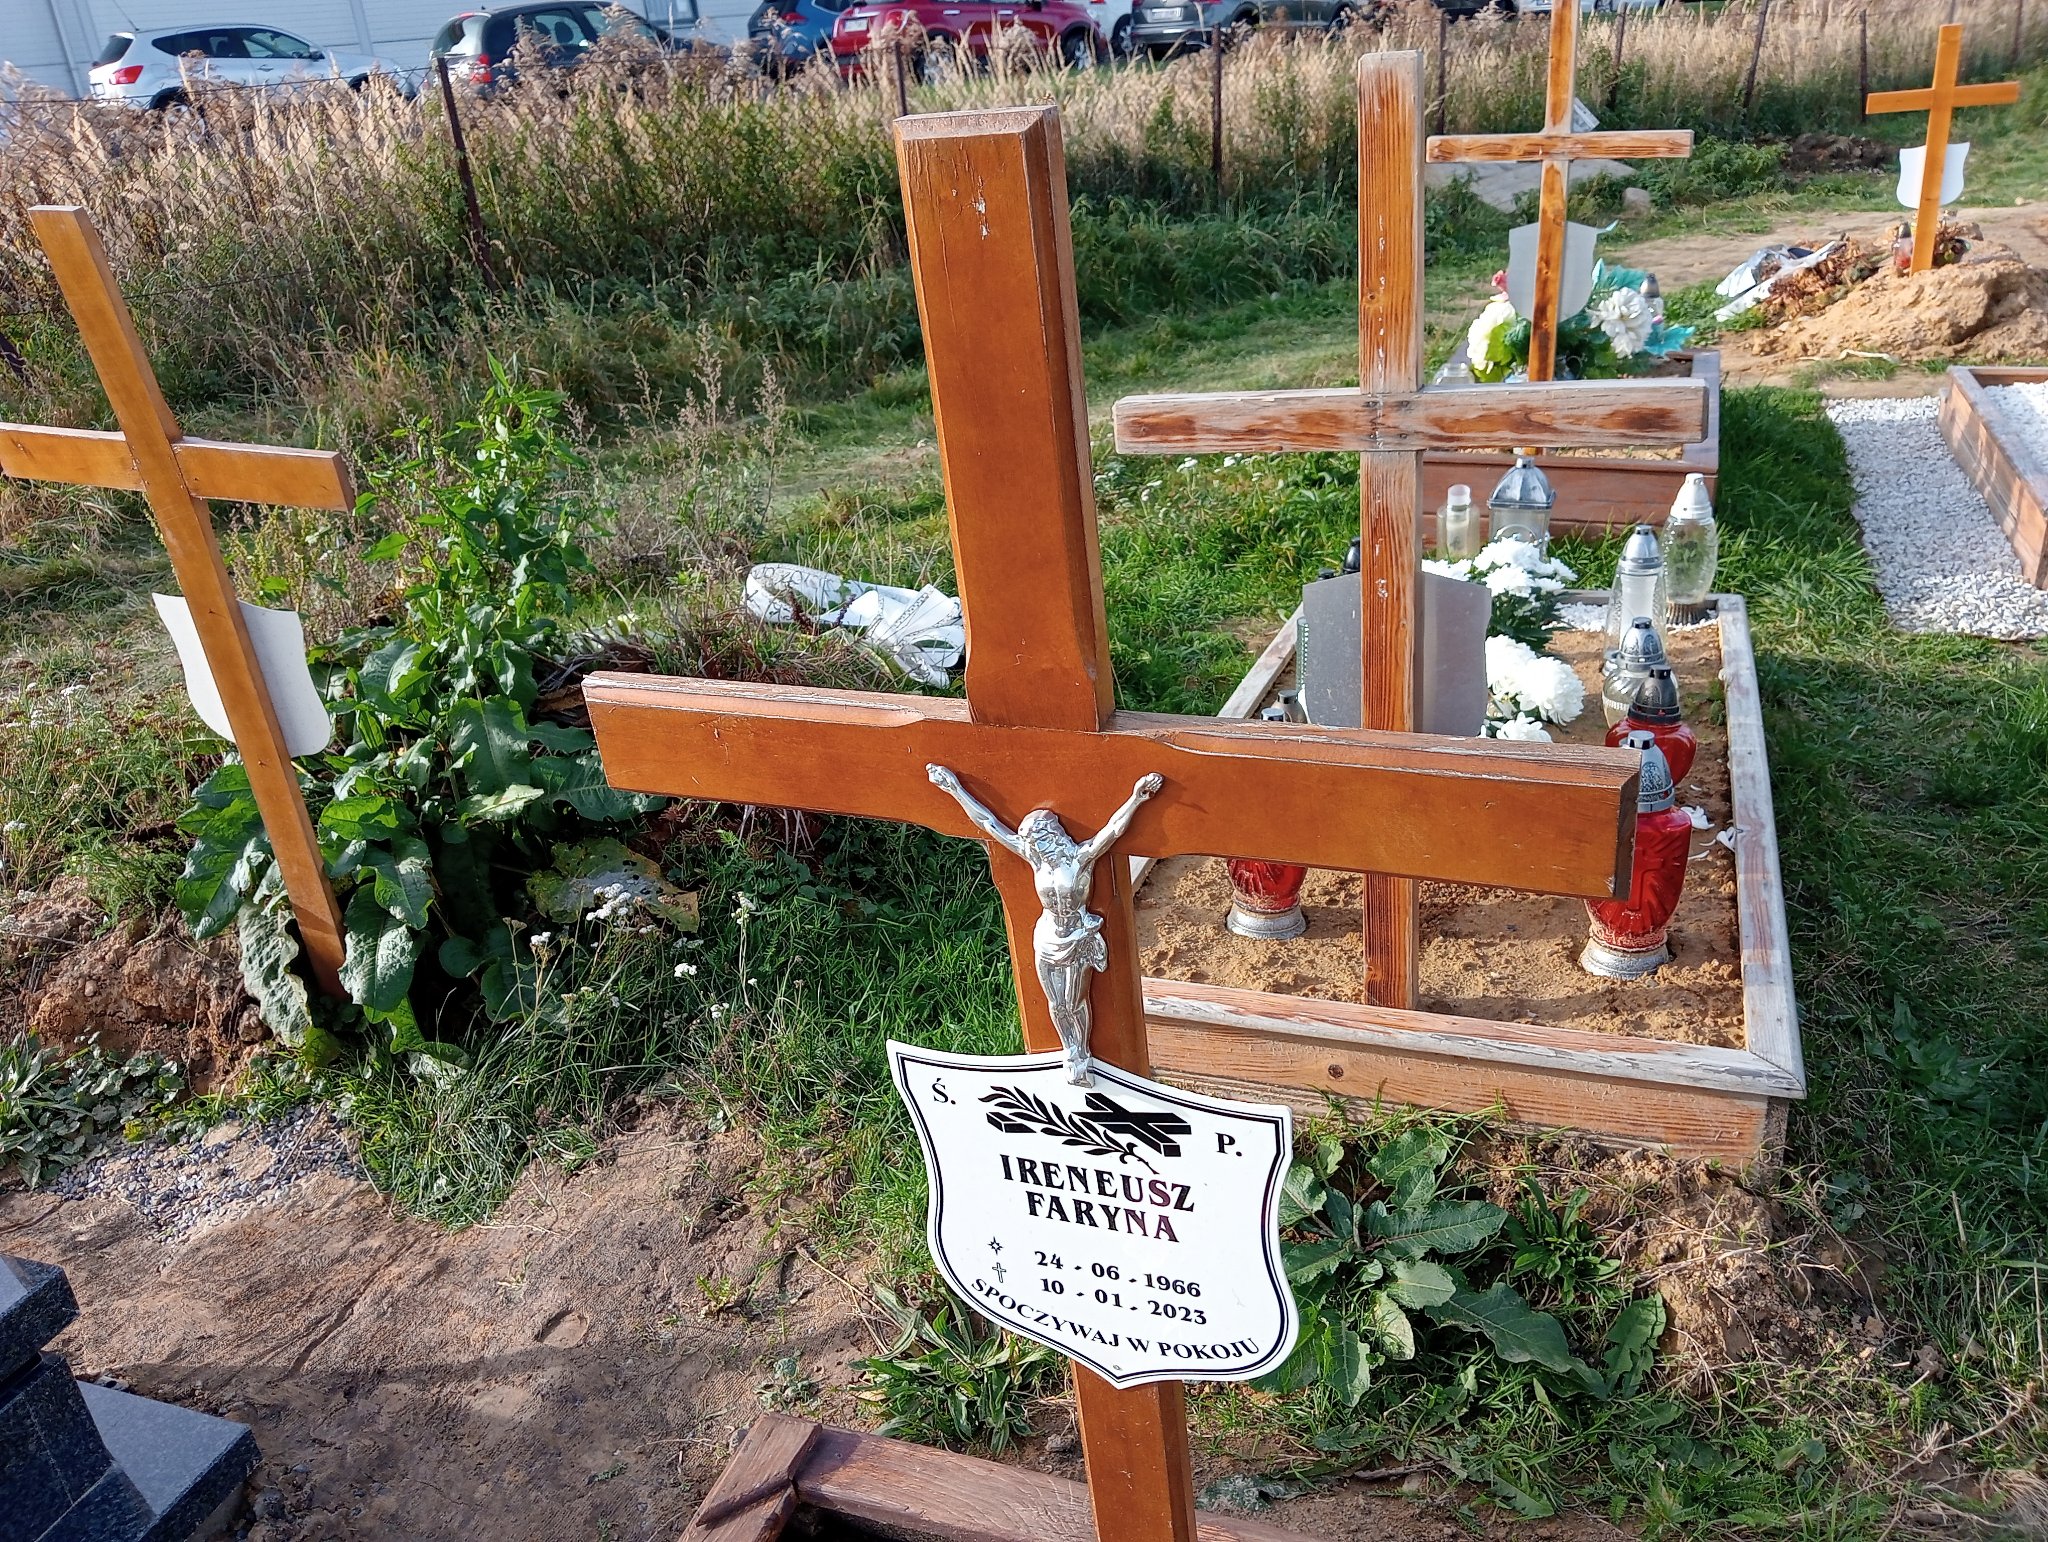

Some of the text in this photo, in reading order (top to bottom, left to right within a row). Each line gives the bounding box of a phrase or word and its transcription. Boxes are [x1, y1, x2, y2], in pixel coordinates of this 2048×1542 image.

[931, 1077, 957, 1104] Ś.
[1215, 1132, 1243, 1157] P.
[999, 1153, 1195, 1213] IRENEUSZ
[1025, 1190, 1180, 1243] FARYNA
[1144, 1273, 1202, 1298] 1966
[971, 1278, 1260, 1360] SPOCZYWAJ W POKOJU
[1147, 1300, 1208, 1325] 2023
